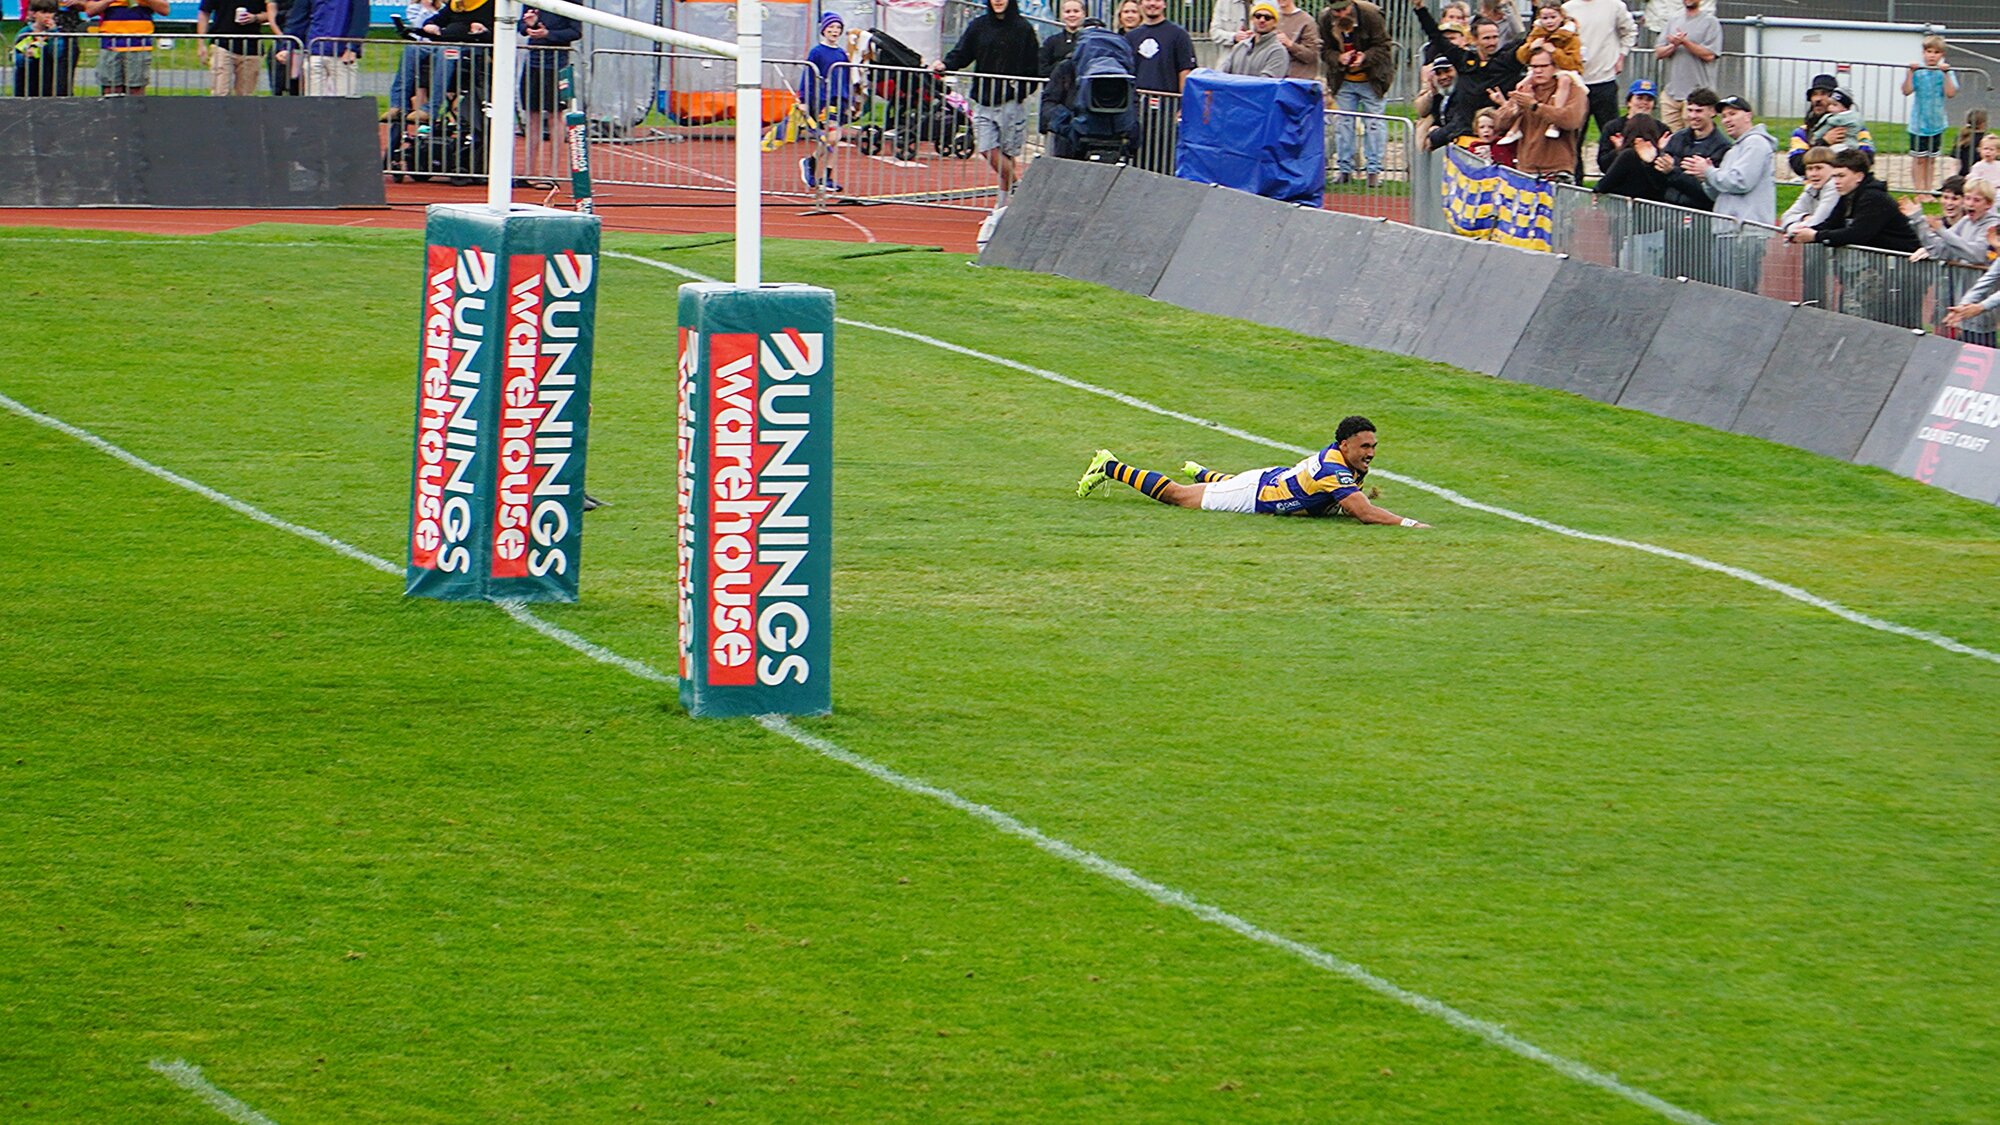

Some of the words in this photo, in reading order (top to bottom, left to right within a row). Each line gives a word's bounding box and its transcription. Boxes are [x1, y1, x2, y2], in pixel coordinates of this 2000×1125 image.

[415, 266, 458, 552] warehouse
[436, 246, 496, 575] BUNNINGS
[495, 273, 548, 561] warehouse
[527, 250, 593, 577] BUNNINGS
[713, 353, 771, 667] warehouse
[757, 328, 824, 686] BUNNINGS
